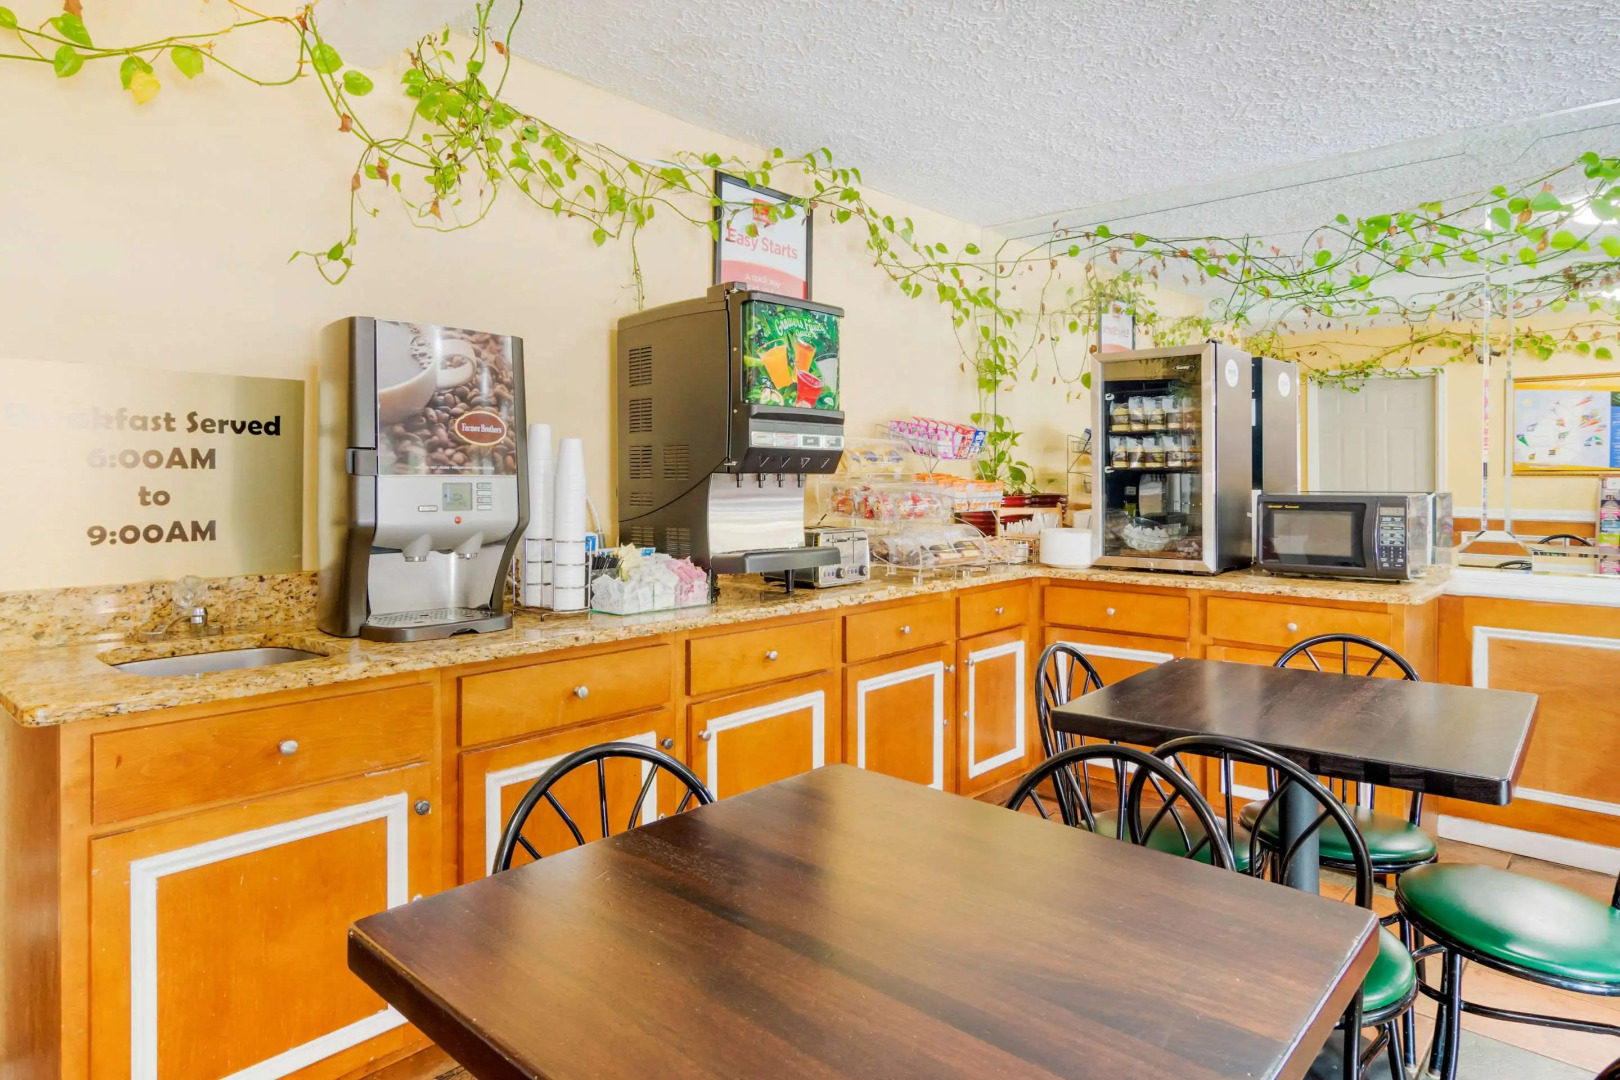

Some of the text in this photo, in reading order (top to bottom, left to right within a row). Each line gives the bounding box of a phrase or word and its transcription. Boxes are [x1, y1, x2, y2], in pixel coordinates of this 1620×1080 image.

[726, 227, 798, 260] Easy Starts
[186, 411, 281, 436] Served
[461, 423, 502, 434] Farmer Brothers
[87, 447, 216, 470] 6:00AM
[138, 486, 171, 506] to
[86, 520, 216, 546] 9:00AM
